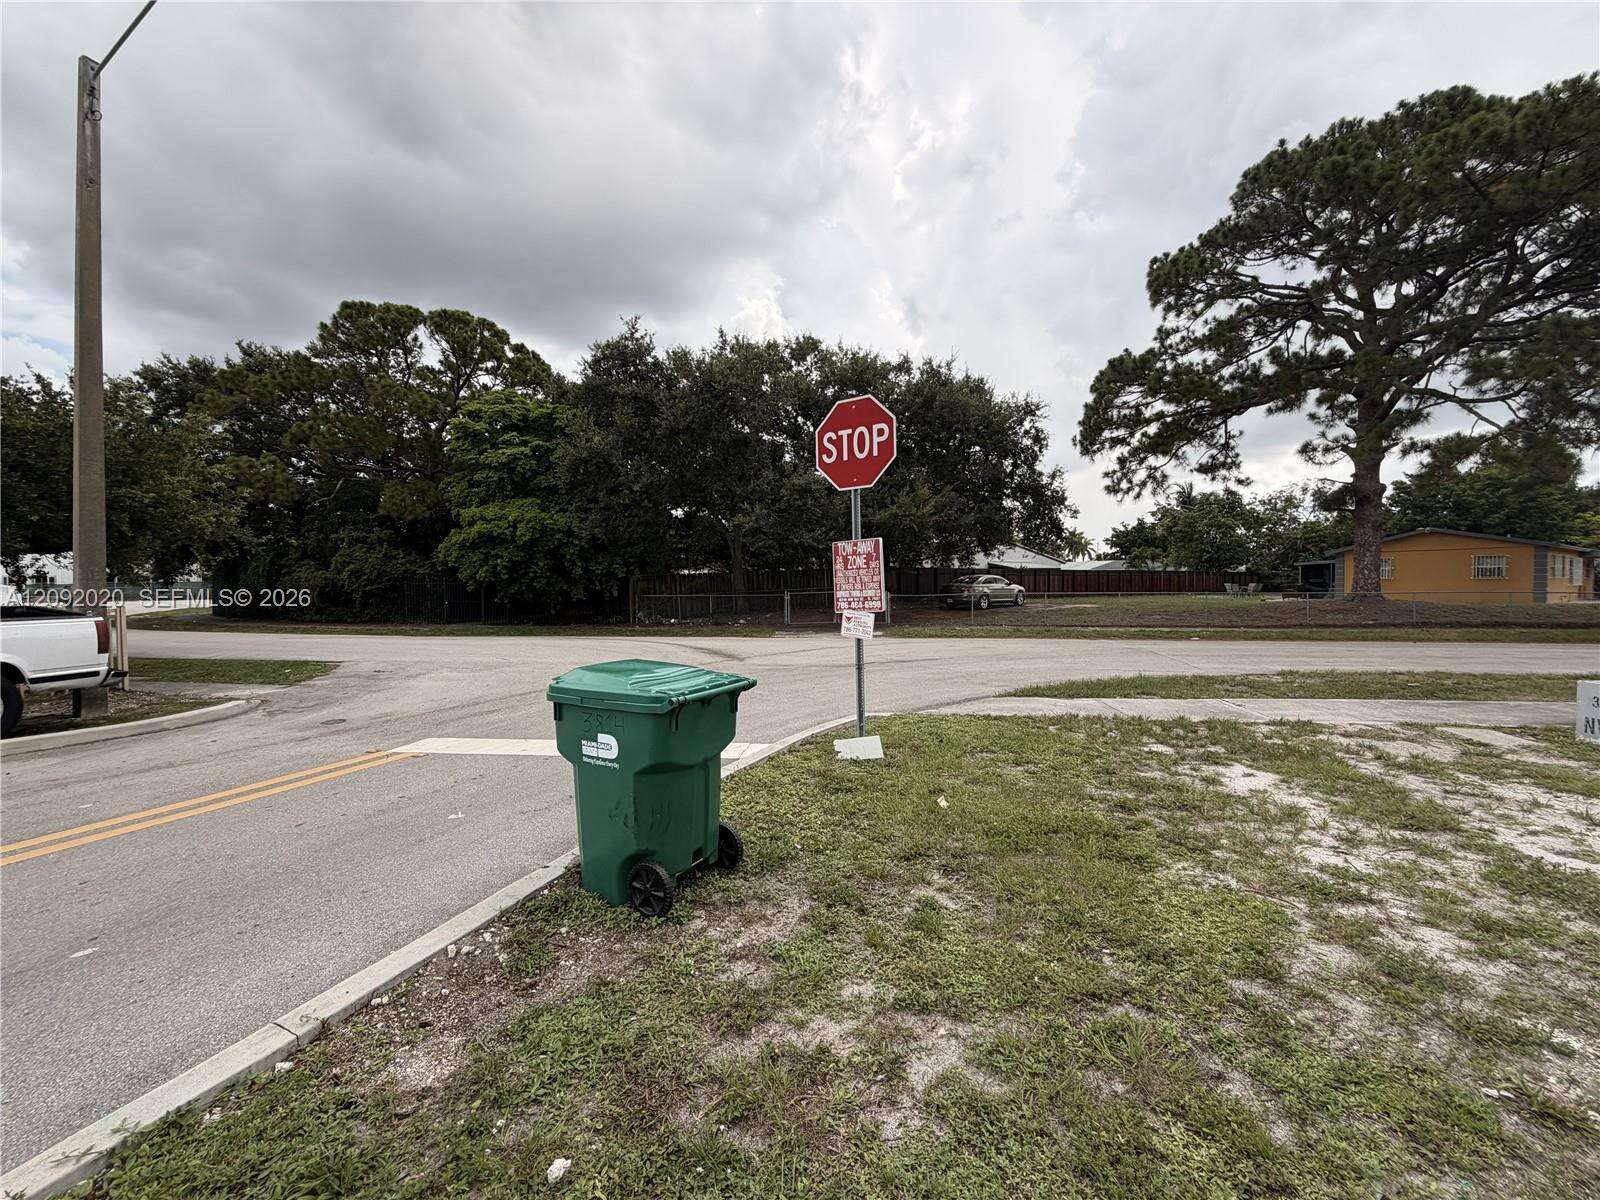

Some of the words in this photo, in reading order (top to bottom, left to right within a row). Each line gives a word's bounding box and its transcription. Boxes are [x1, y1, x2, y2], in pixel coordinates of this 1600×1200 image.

[822, 423, 889, 464] STOP
[837, 540, 875, 555] TOW-AWAY
[847, 555, 867, 569] ZONE
[1584, 716, 1600, 735] N
